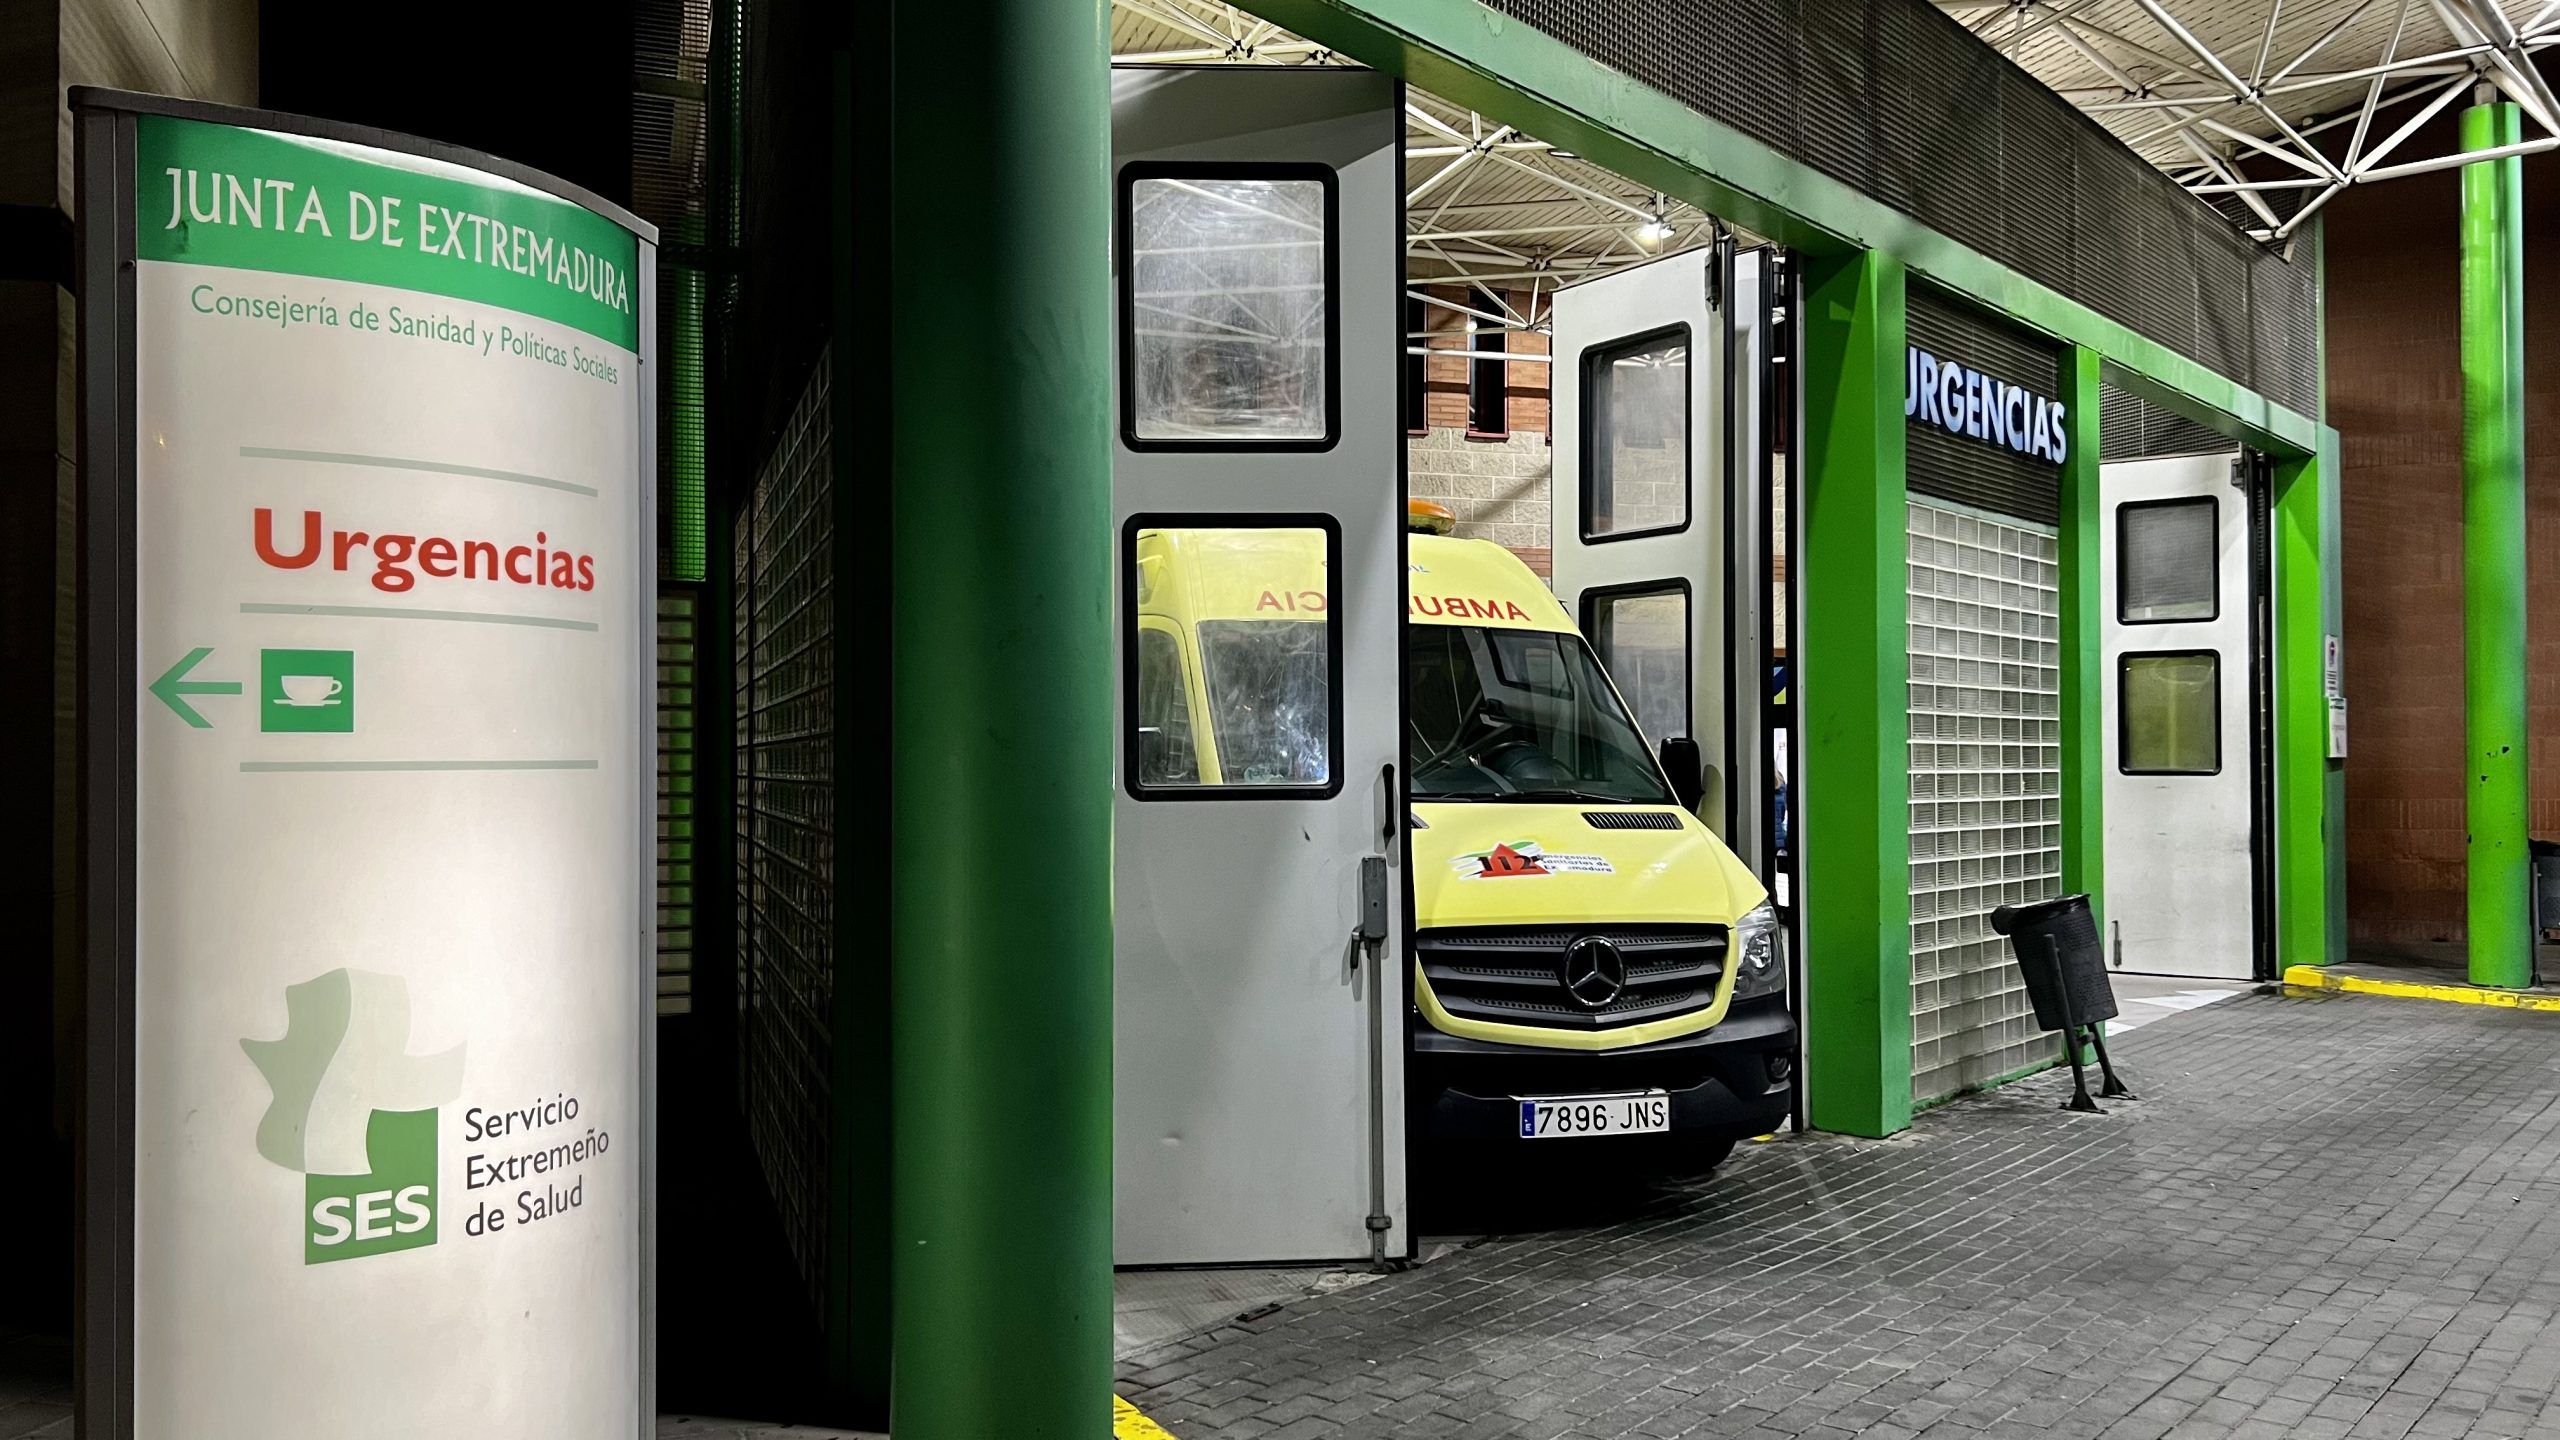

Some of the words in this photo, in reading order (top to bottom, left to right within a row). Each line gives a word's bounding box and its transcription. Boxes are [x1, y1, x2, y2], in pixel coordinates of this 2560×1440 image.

[165, 167, 332, 238] JUNTA
[348, 190, 404, 249] DE
[419, 202, 630, 314] EXTREMADURA
[190, 284, 339, 329] Consejería
[349, 301, 380, 331] de
[388, 306, 476, 346] Sanidad
[482, 328, 494, 356] y
[500, 325, 568, 367] Políticas
[572, 345, 618, 385] Sociales
[253, 507, 596, 593] Urgencias
[1477, 855, 1538, 872] 112
[465, 1092, 579, 1141] Servicio
[1538, 1104, 1608, 1134] 7896
[1619, 1101, 1665, 1130] JNS
[466, 1127, 609, 1190] Extremeño
[312, 1184, 431, 1246] SES
[465, 1202, 506, 1237] de
[517, 1174, 583, 1225] Salud
